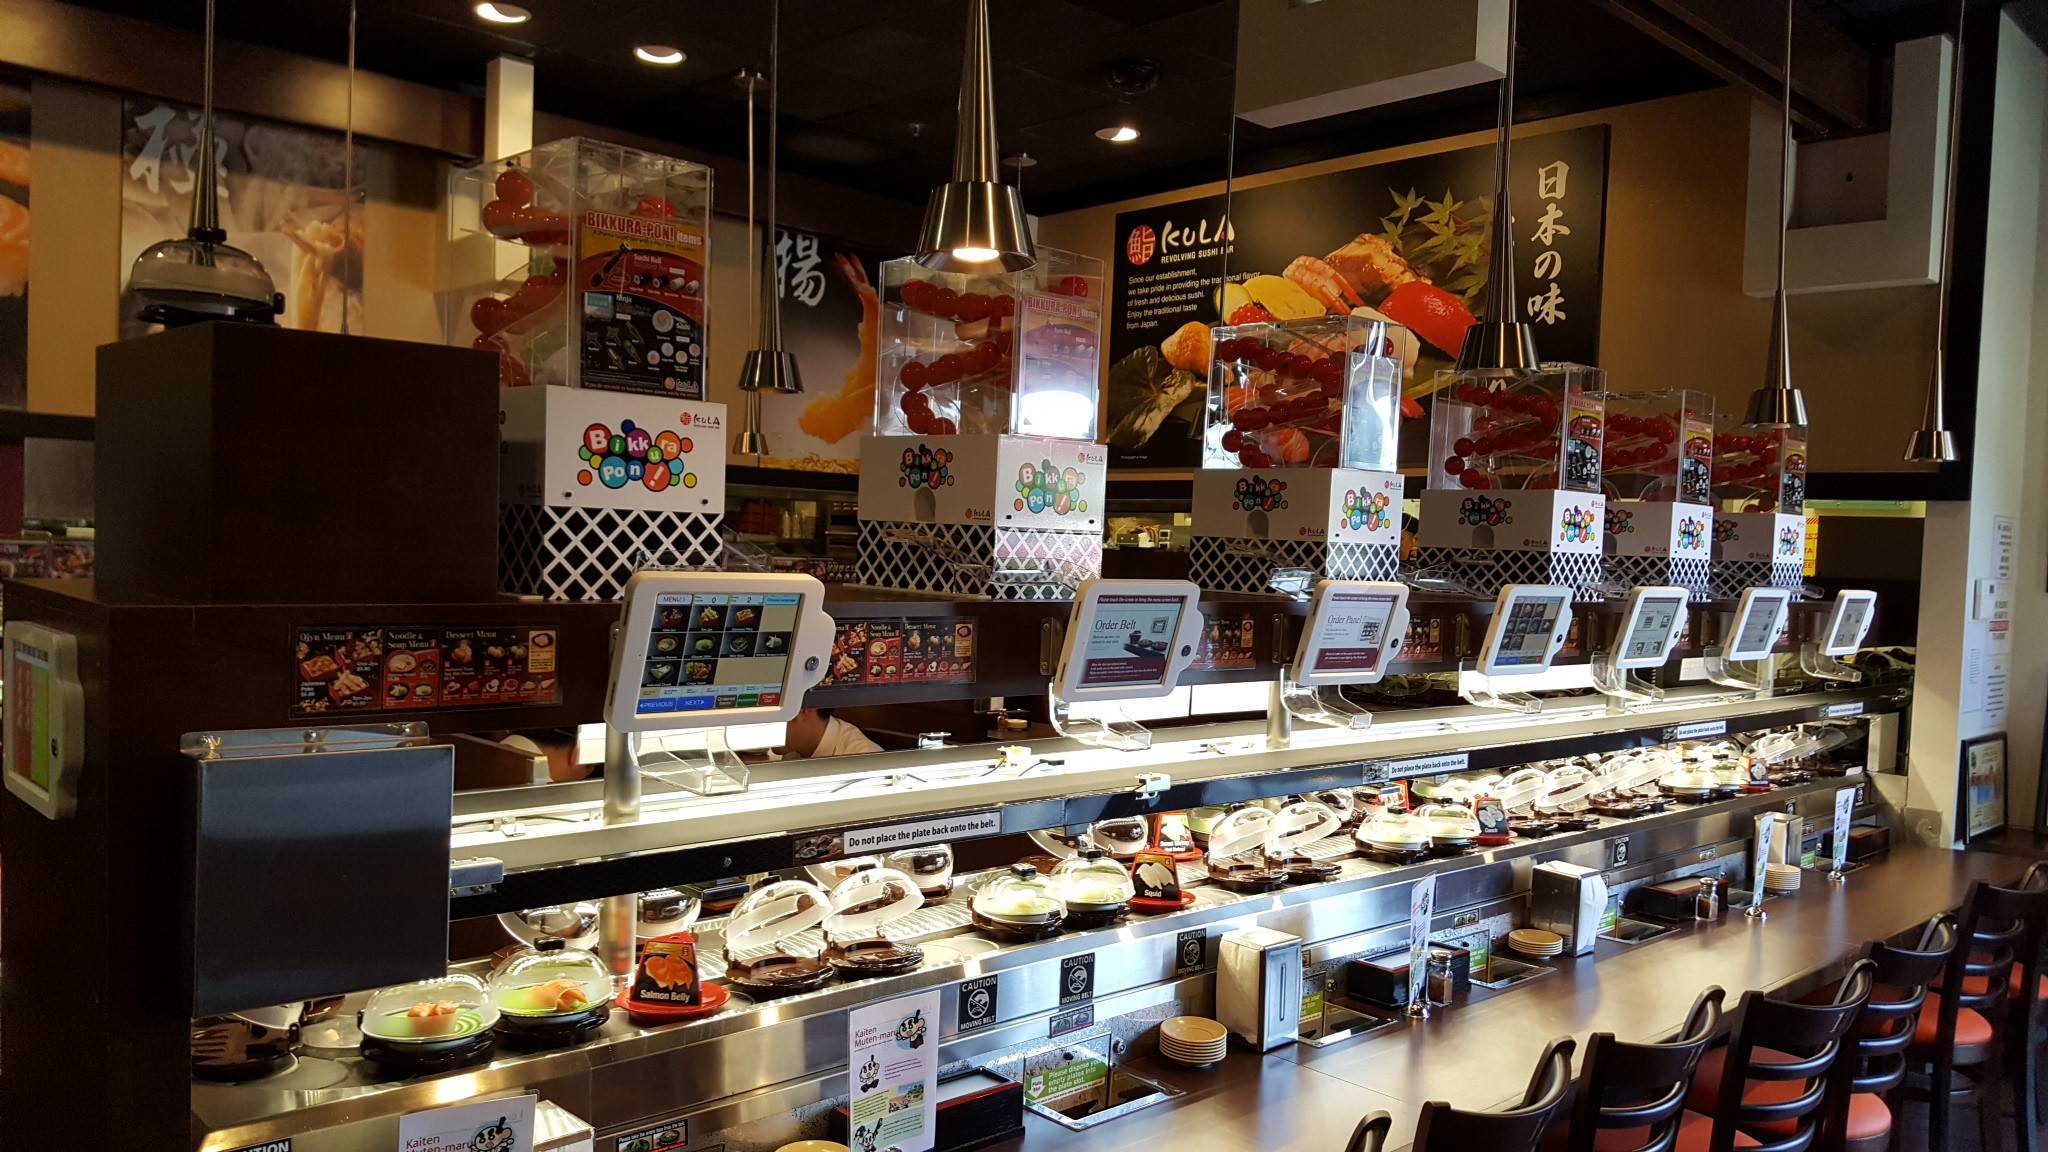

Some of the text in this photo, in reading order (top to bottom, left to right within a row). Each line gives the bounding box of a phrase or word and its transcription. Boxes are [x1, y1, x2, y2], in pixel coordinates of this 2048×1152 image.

[1528, 160, 1571, 325] 日本の味
[1160, 251, 1196, 264] REVOLVING
[1198, 247, 1219, 258] SUSHI
[1095, 619, 1137, 631] Order Belt
[849, 818, 997, 847] Do not place the plate back onto the belt.
[1143, 889, 1163, 898] Squid
[1179, 930, 1206, 941] CAUTION
[1063, 954, 1094, 969] CAUTION
[961, 976, 997, 992] CAUTION
[640, 989, 691, 1004] Salmon Belly
[1061, 991, 1093, 1006] MOVING BELT
[960, 1015, 996, 1030] MOVING BELT
[855, 1026, 877, 1038] Kaiten
[406, 1135, 440, 1149] Kaiten
